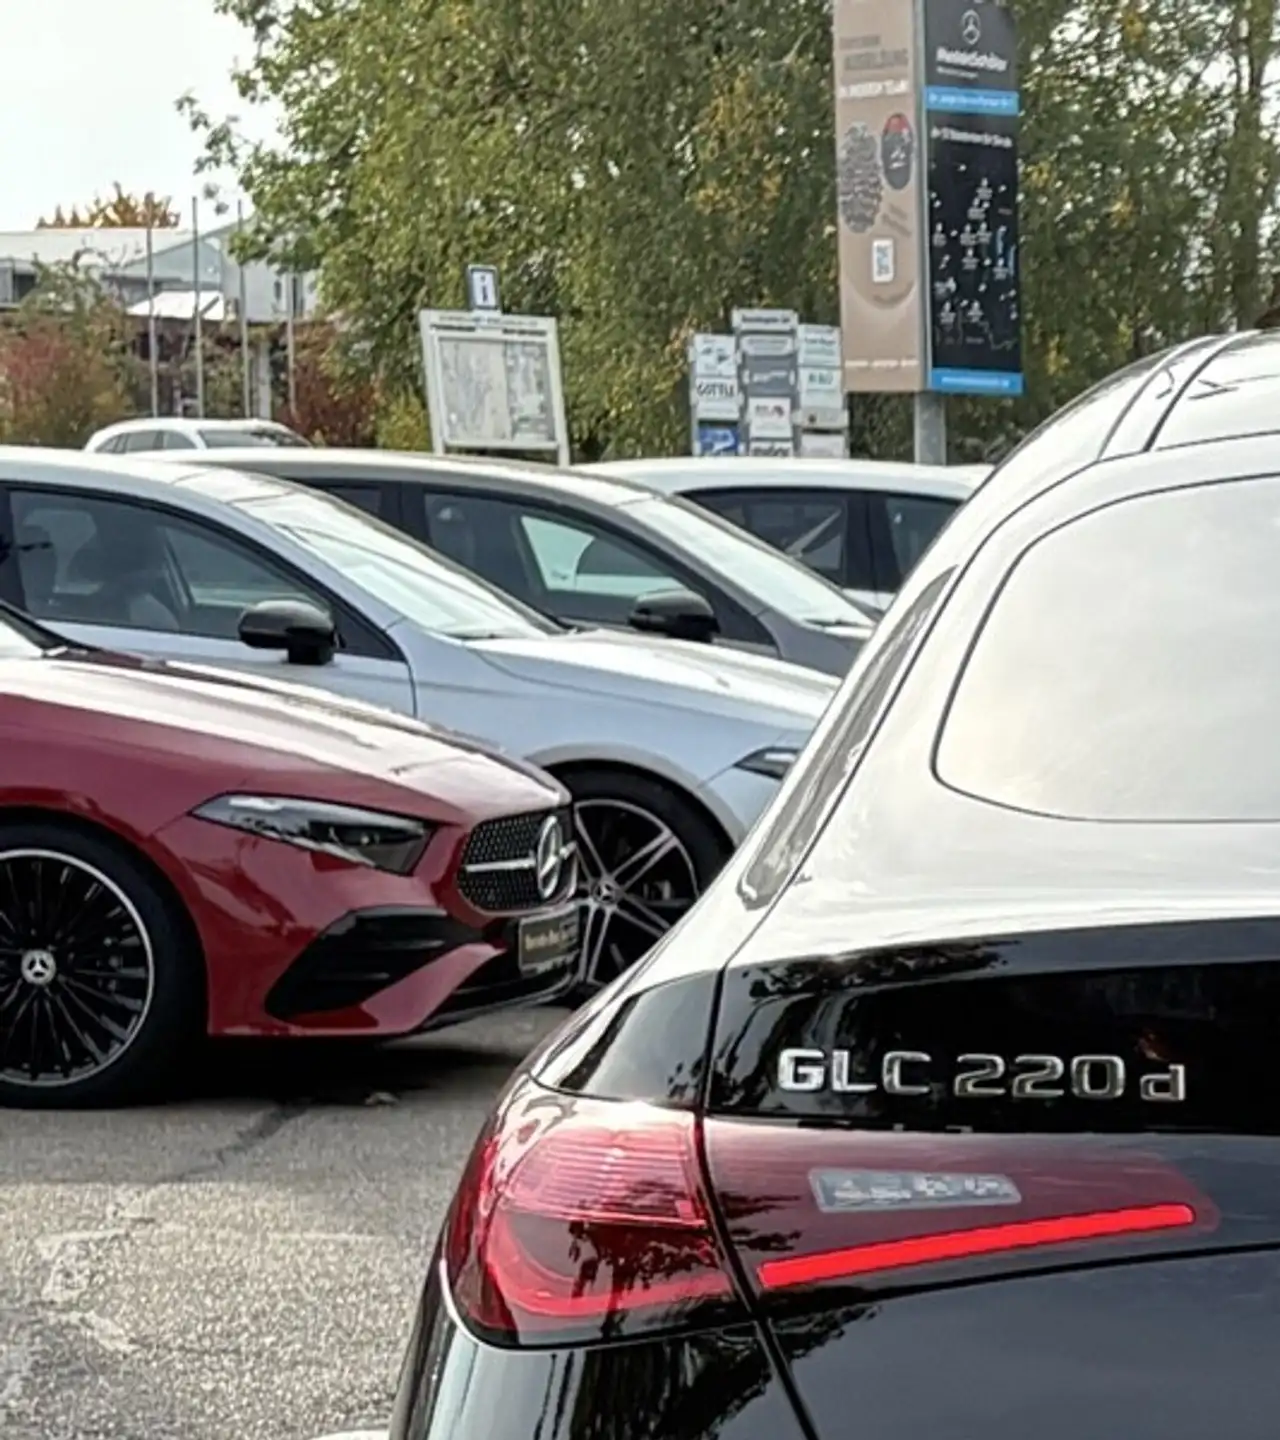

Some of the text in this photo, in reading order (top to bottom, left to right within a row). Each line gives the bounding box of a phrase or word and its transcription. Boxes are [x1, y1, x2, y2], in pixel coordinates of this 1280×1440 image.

[777, 1047, 1187, 1102] GLC 220 d
